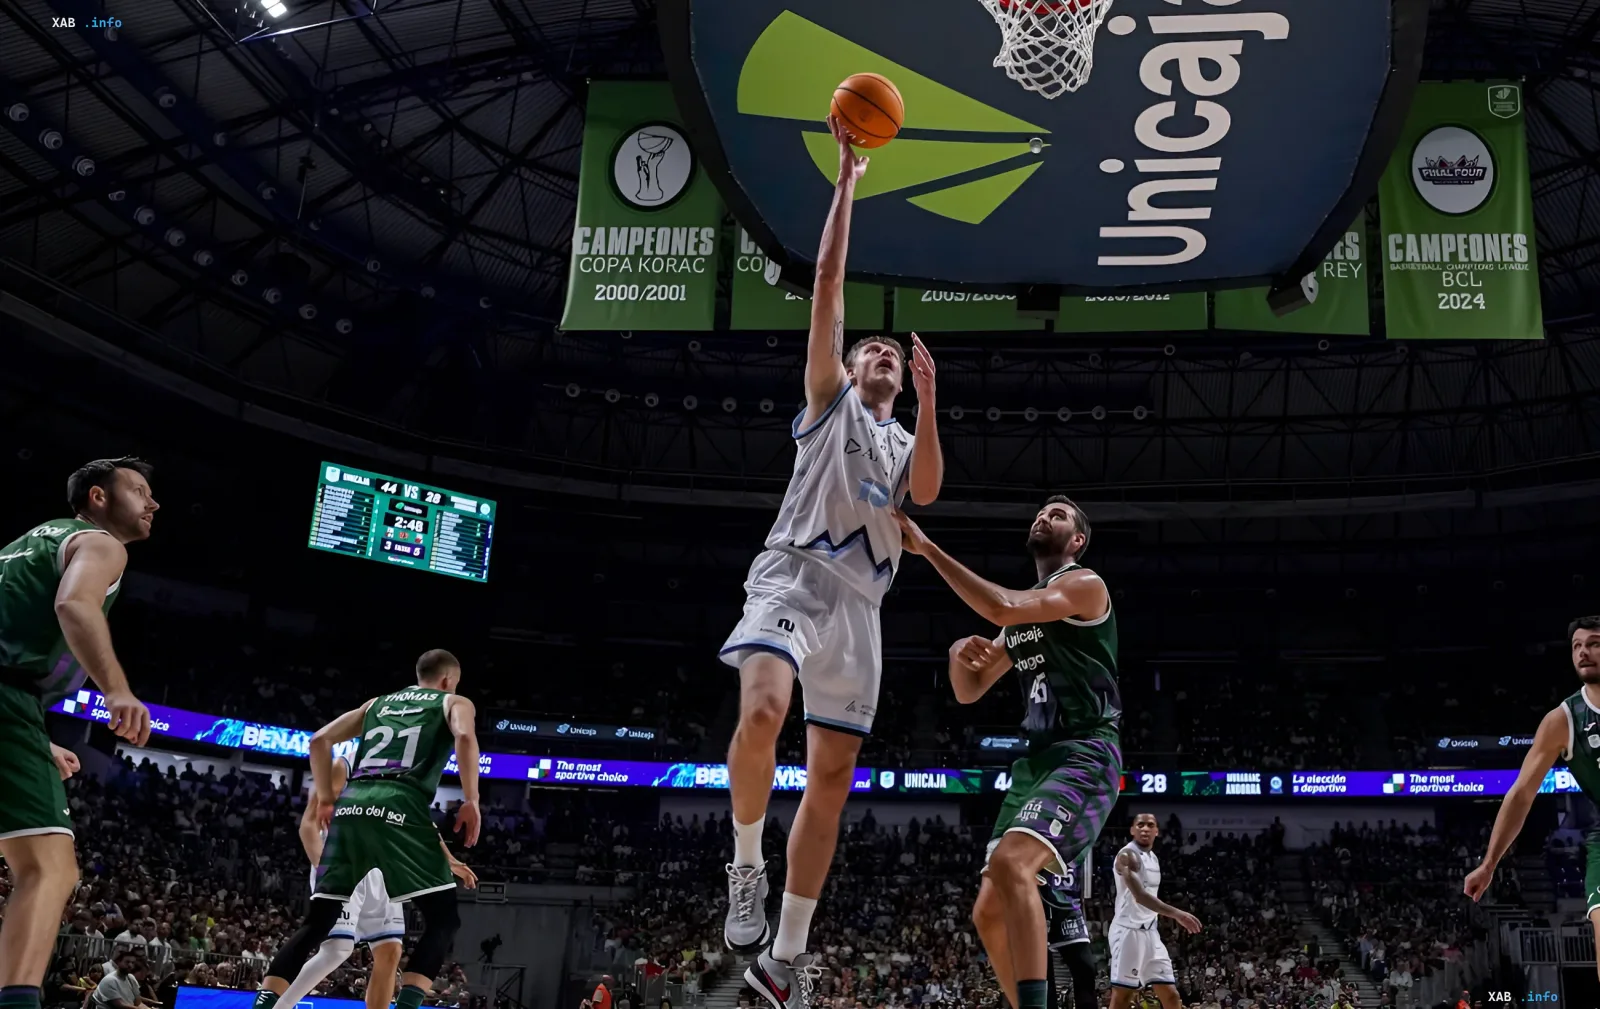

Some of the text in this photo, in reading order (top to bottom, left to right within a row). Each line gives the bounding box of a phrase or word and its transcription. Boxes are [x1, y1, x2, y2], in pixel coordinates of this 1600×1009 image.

[1097, 0, 1290, 266] Unicaj
[574, 226, 715, 256] CAMPEONES
[1388, 233, 1529, 263] CAMPEONES
[579, 256, 705, 273] COPA KORAC
[1323, 262, 1363, 279] REY
[1442, 271, 1482, 287] BCL
[594, 284, 687, 301] 2000/2001
[1437, 293, 1486, 310] 2024
[381, 481, 398, 495] 44
[404, 483, 419, 499] VS
[425, 491, 442, 505] 28
[384, 691, 439, 702] THOMAS
[358, 725, 422, 769] 21
[556, 760, 601, 771] The most
[555, 770, 628, 782] sportive choice
[904, 772, 947, 789] UNICAJA
[1141, 773, 1167, 793] 28
[1292, 774, 1305, 783] La
[1409, 774, 1454, 783] The most
[1300, 783, 1346, 794] deportiva
[1409, 782, 1484, 793] sportive choice
